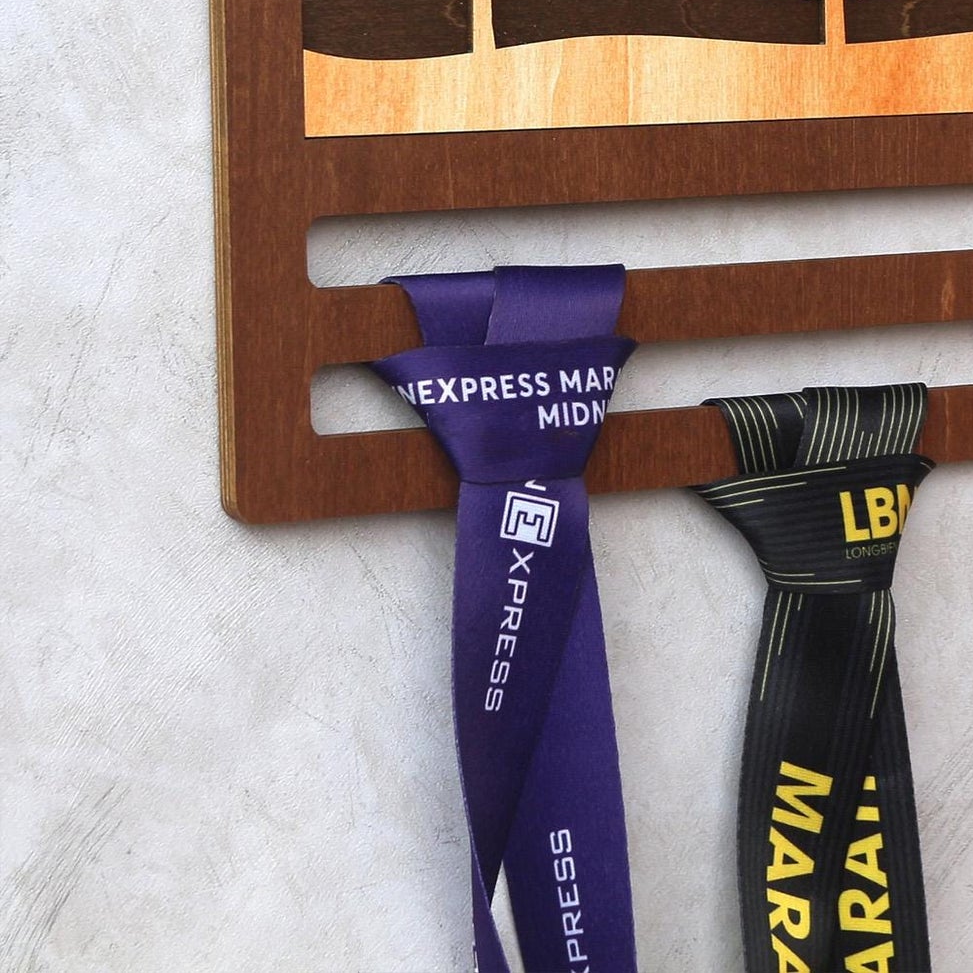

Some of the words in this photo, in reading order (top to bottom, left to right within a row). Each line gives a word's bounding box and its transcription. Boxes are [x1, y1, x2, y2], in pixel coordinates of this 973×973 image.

[394, 372, 550, 406] NEXPRESS
[559, 366, 621, 394] MAR
[537, 399, 608, 430] MIDN
